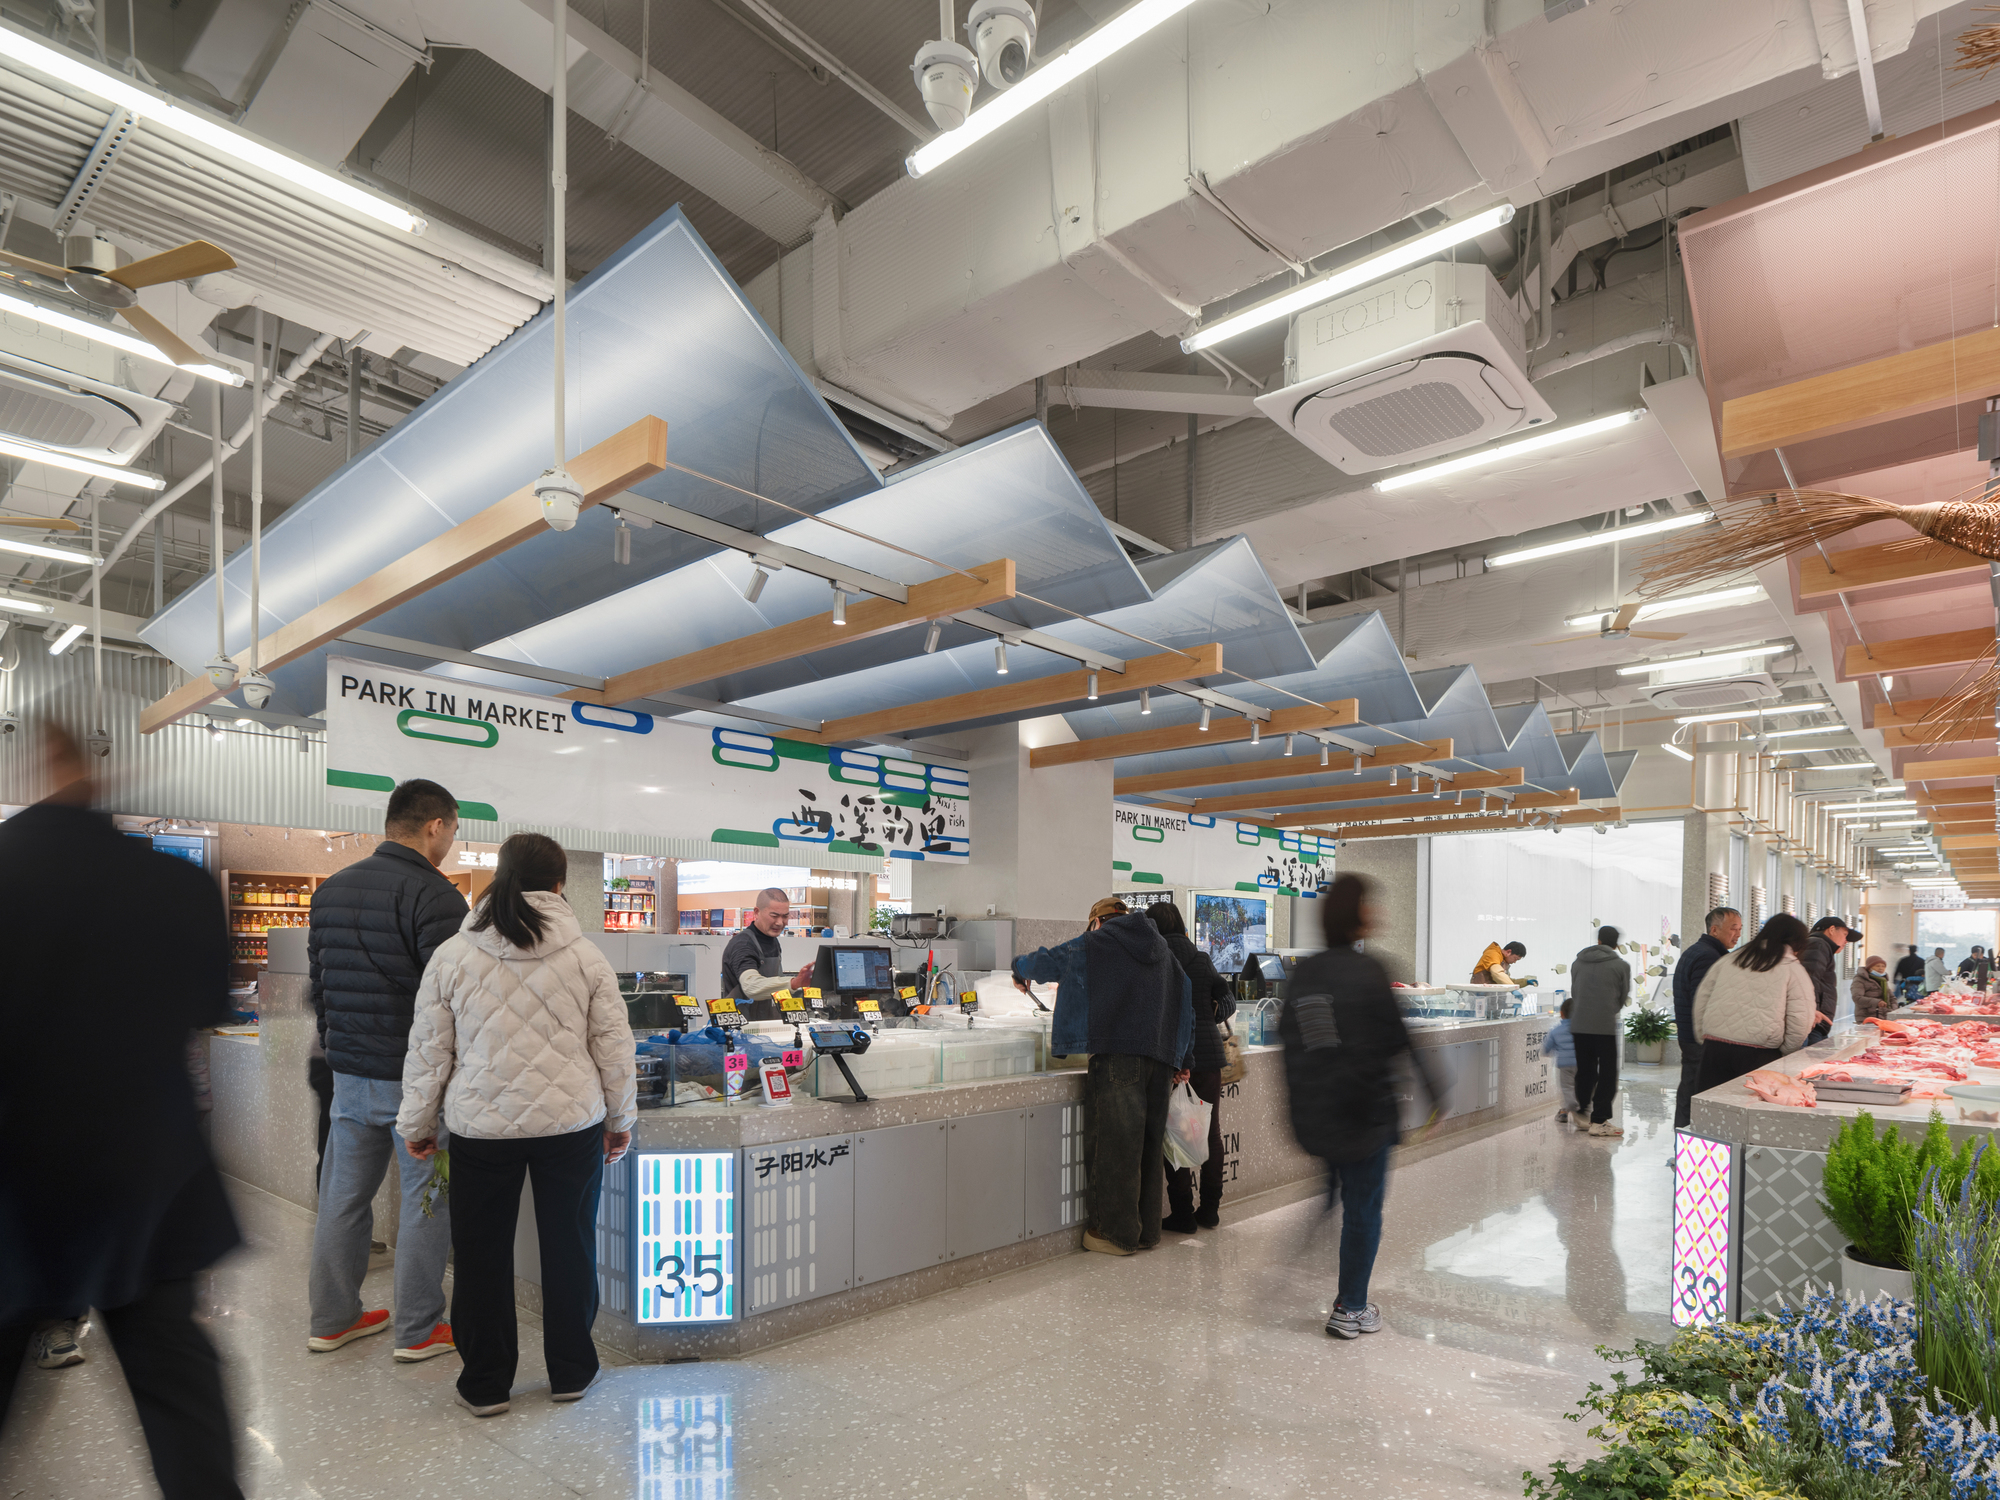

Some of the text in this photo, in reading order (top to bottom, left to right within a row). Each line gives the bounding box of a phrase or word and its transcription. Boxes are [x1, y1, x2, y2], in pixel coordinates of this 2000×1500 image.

[341, 675, 567, 734] PARK IN MARKET
[1115, 809, 1187, 832] PARK IN MARKET
[1525, 1049, 1540, 1064] PARK
[1540, 1064, 1548, 1077] IN
[1524, 1080, 1547, 1098] MARKET
[1223, 1132, 1240, 1155] IN
[755, 1144, 850, 1179] 子阳水产
[655, 1254, 724, 1299] 35
[1681, 1265, 1721, 1323] 33
